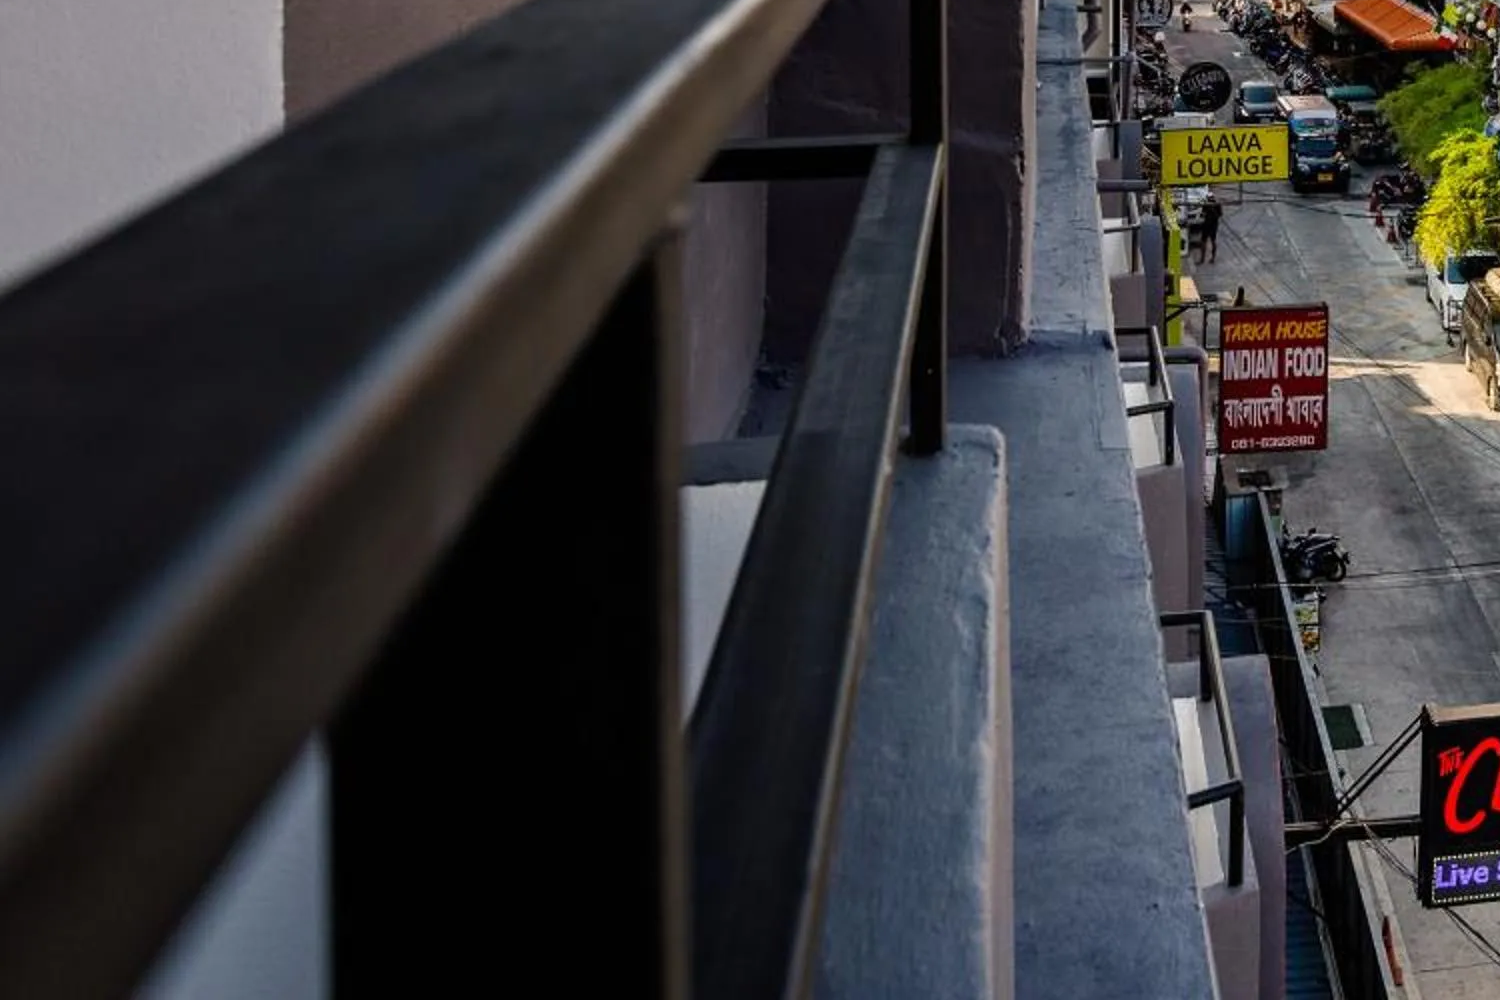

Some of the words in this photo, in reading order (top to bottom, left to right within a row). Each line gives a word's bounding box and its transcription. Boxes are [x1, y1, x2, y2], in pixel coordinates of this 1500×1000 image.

[1186, 131, 1263, 156] LAAVA
[1175, 154, 1274, 179] LOUNGE
[1222, 321, 1272, 344] TARKA
[1274, 318, 1327, 340] HOUSE
[1222, 347, 1279, 381] INDIAN
[1283, 345, 1326, 378] FOOD
[1435, 862, 1489, 890] Live
